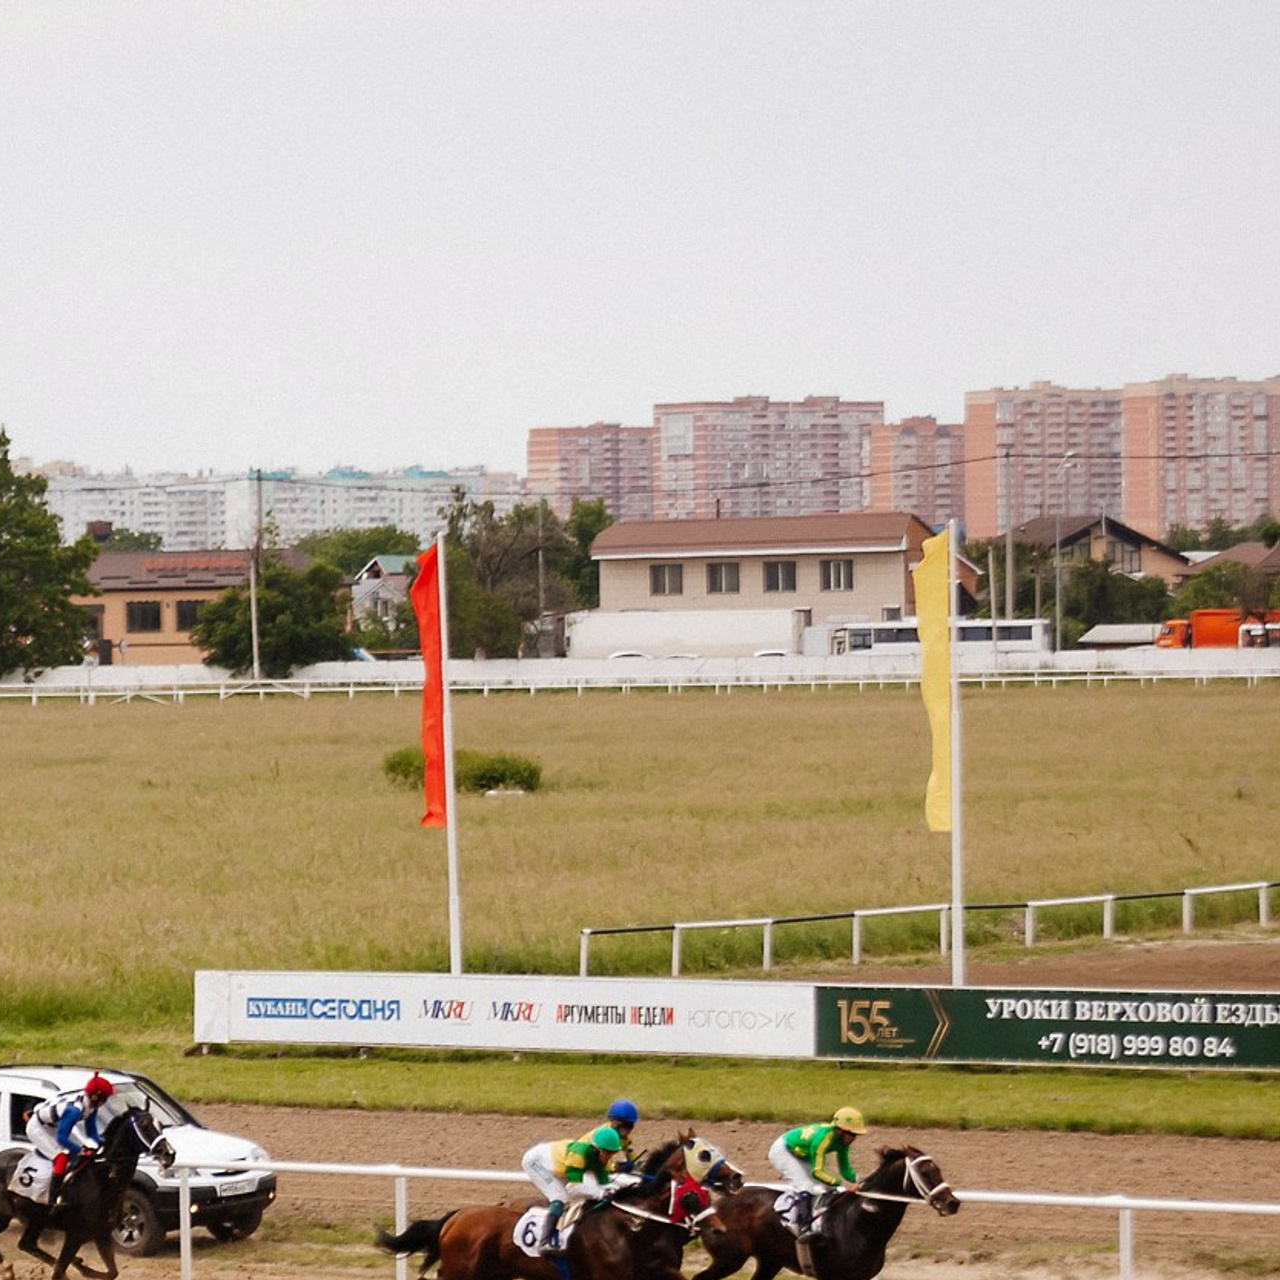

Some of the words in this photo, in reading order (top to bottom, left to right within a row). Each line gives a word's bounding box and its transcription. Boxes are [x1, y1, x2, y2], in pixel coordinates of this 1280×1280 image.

[248, 999, 306, 1016] КУБАНЬ
[310, 999, 401, 1020] СЕГОДНЯ
[556, 1003, 626, 1025] АРГУМЕНТЫ
[631, 1005, 674, 1027] НЕДЕЛИ
[985, 999, 1070, 1020] УРОКИ
[1074, 998, 1211, 1023] ВЕРХОВОЙ
[837, 1000, 891, 1044] 155
[876, 1027, 898, 1038] ЛЕТ
[1037, 1033, 1065, 1053] +7
[1069, 1033, 1118, 1059] (918)
[1123, 1035, 1166, 1056] 999
[1168, 1036, 1199, 1057] 80
[1202, 1037, 1237, 1058] 84
[18, 1166, 38, 1188] 5
[522, 1221, 537, 1248] 6
